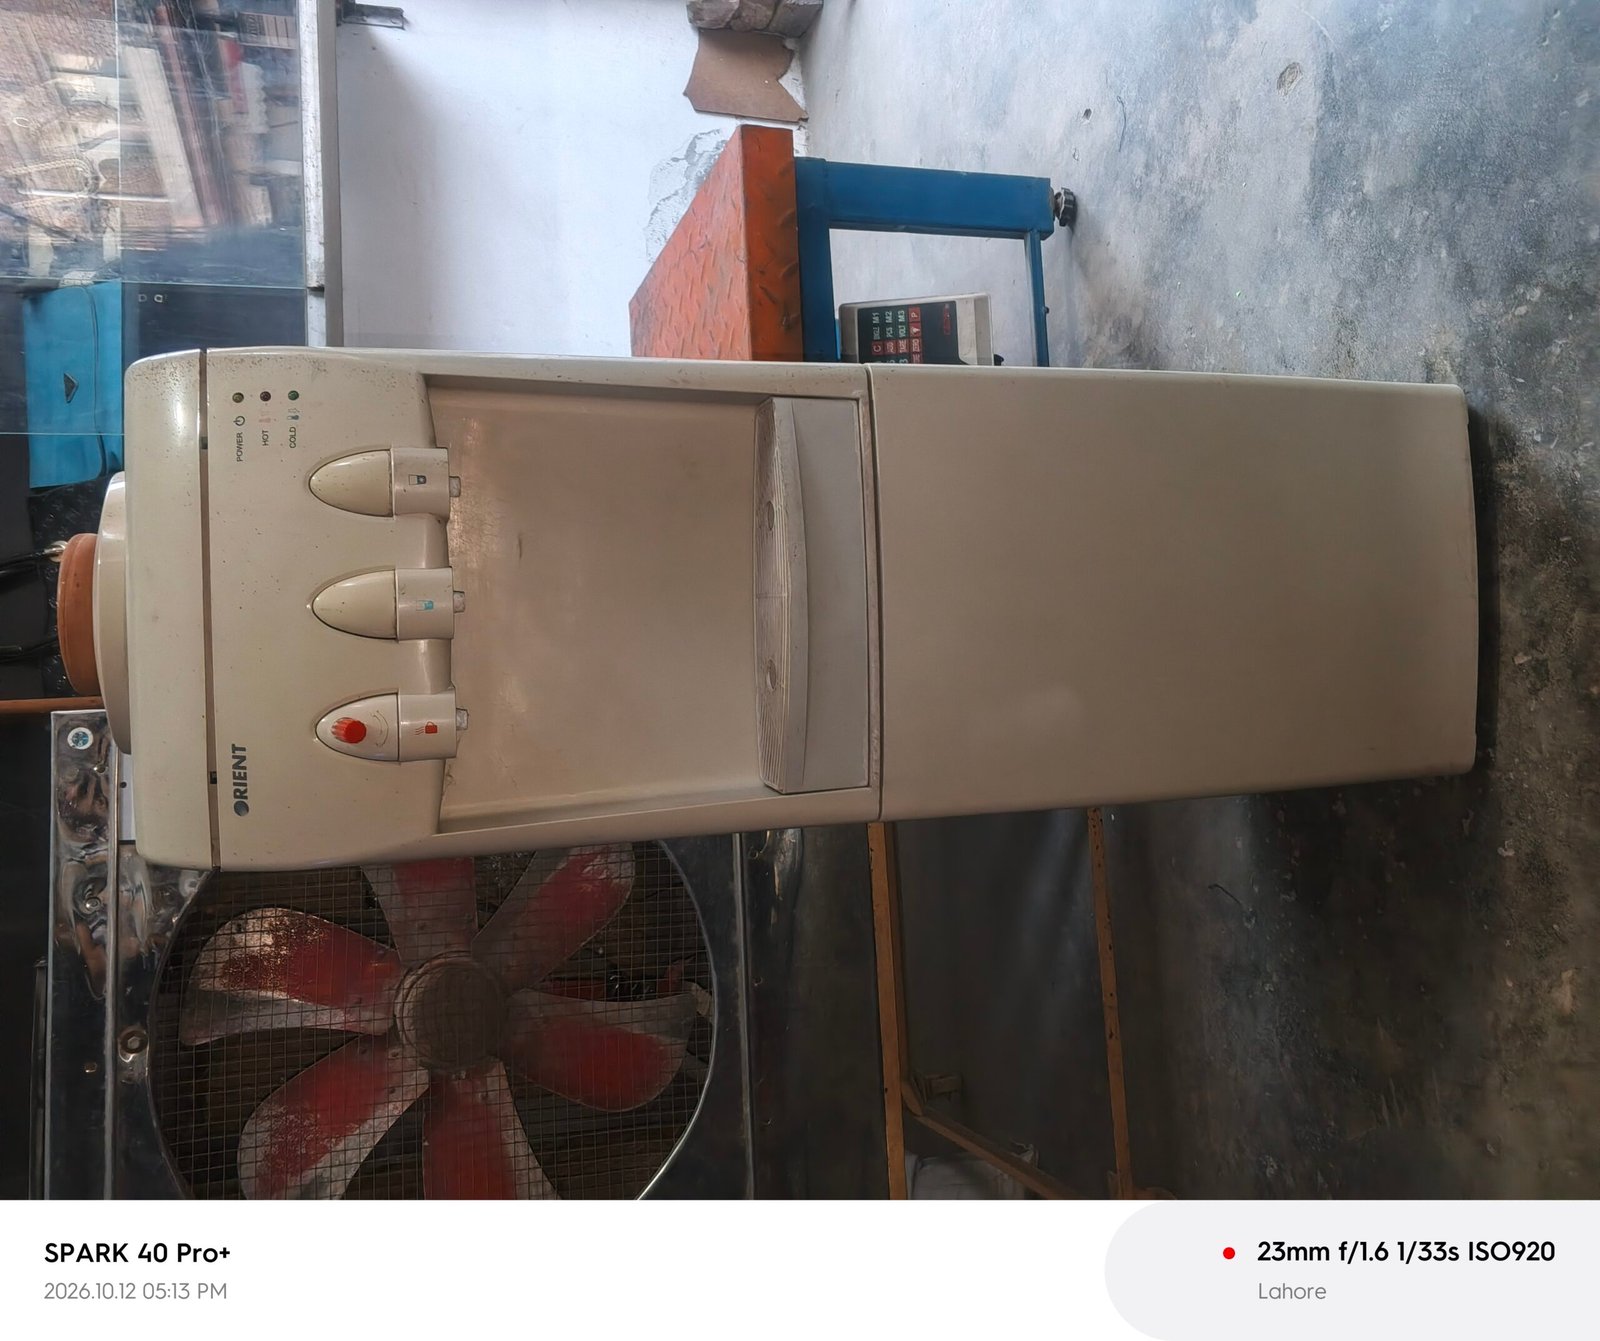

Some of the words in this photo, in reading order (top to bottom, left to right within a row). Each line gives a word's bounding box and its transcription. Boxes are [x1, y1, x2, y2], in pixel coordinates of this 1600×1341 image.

[872, 312, 880, 324] M1
[885, 311, 893, 323] M2
[898, 310, 905, 322] M3
[898, 325, 906, 338] VOLT
[912, 338, 920, 352] ZERO
[262, 429, 270, 446] HOT
[289, 426, 297, 449] COLD
[236, 432, 244, 462] POWER
[231, 743, 250, 817] ORIENT
